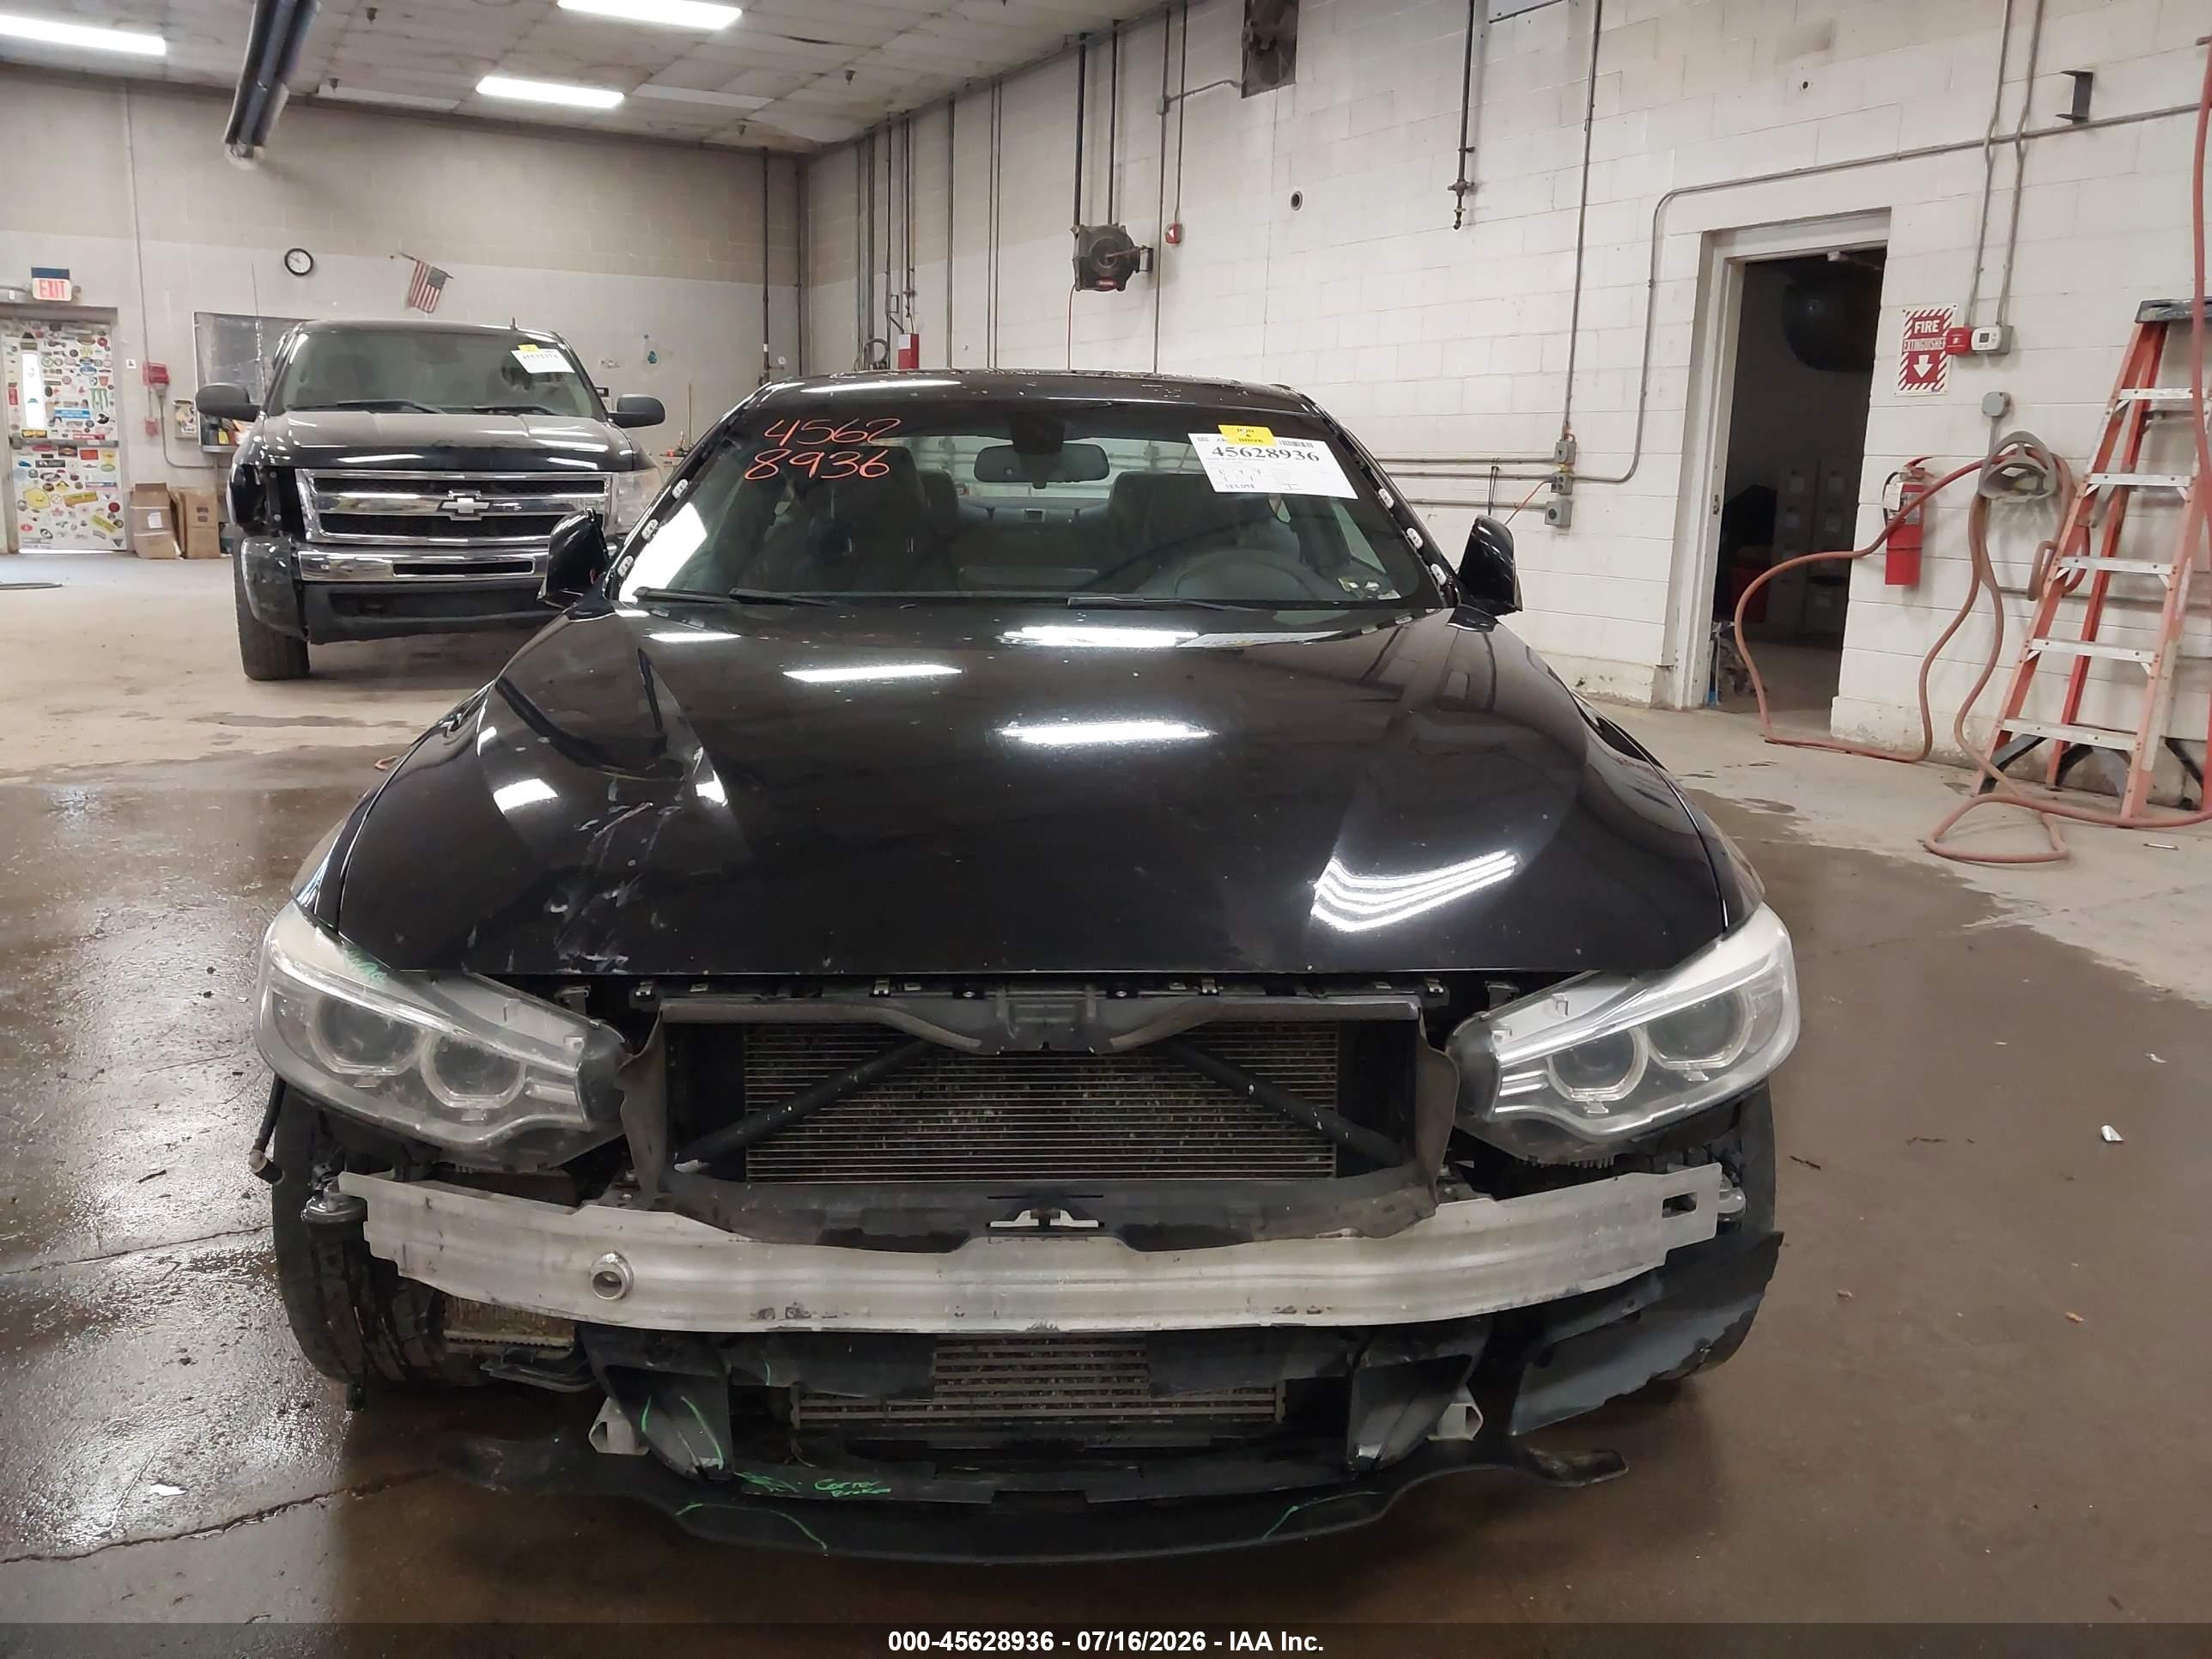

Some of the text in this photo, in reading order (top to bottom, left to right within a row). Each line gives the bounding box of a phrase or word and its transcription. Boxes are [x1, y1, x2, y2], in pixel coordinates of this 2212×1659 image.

[40, 279, 65, 299] EXIT
[1914, 320, 1940, 334] FIRE
[763, 418, 901, 447] 4562
[744, 448, 890, 480] 8936
[1212, 446, 1320, 462] 45628936
